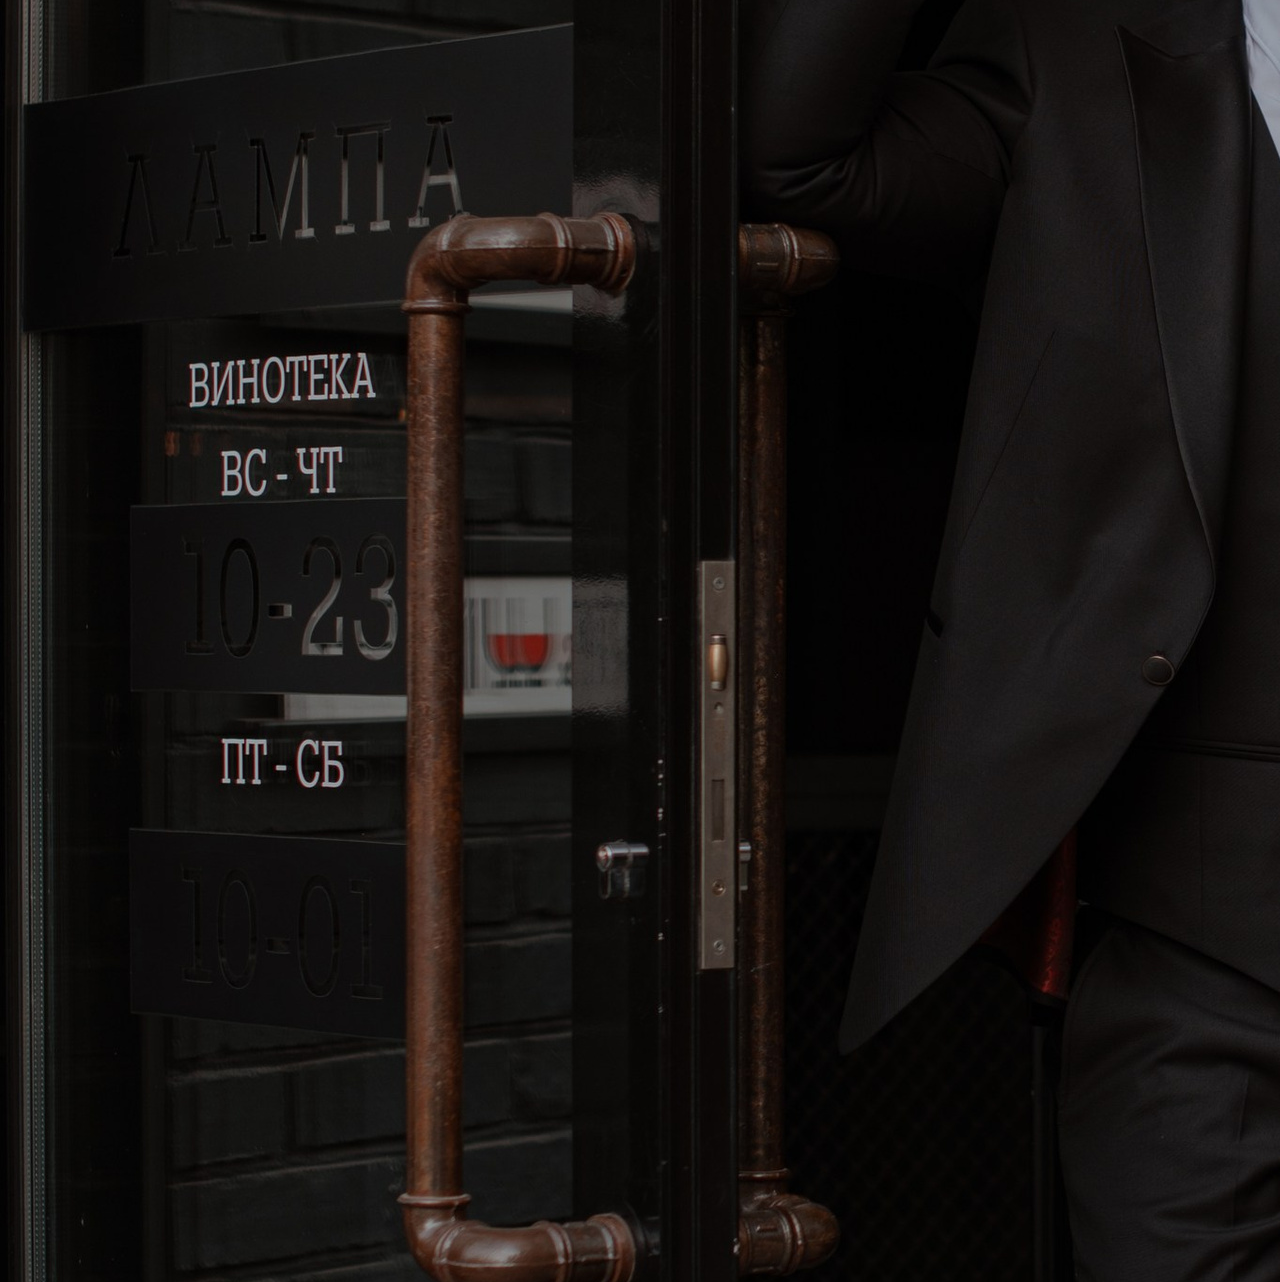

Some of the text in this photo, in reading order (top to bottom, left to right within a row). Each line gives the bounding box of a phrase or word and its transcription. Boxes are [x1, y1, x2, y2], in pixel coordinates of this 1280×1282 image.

[112, 114, 471, 259] ЛАМПА
[188, 352, 376, 408] ВИНОТЕКА
[220, 448, 267, 497] ВС
[295, 446, 343, 494] ЧТ
[182, 532, 398, 661] 10-23
[220, 738, 267, 784] ПТ
[296, 739, 344, 788] СБ
[181, 867, 384, 999] 10-01
